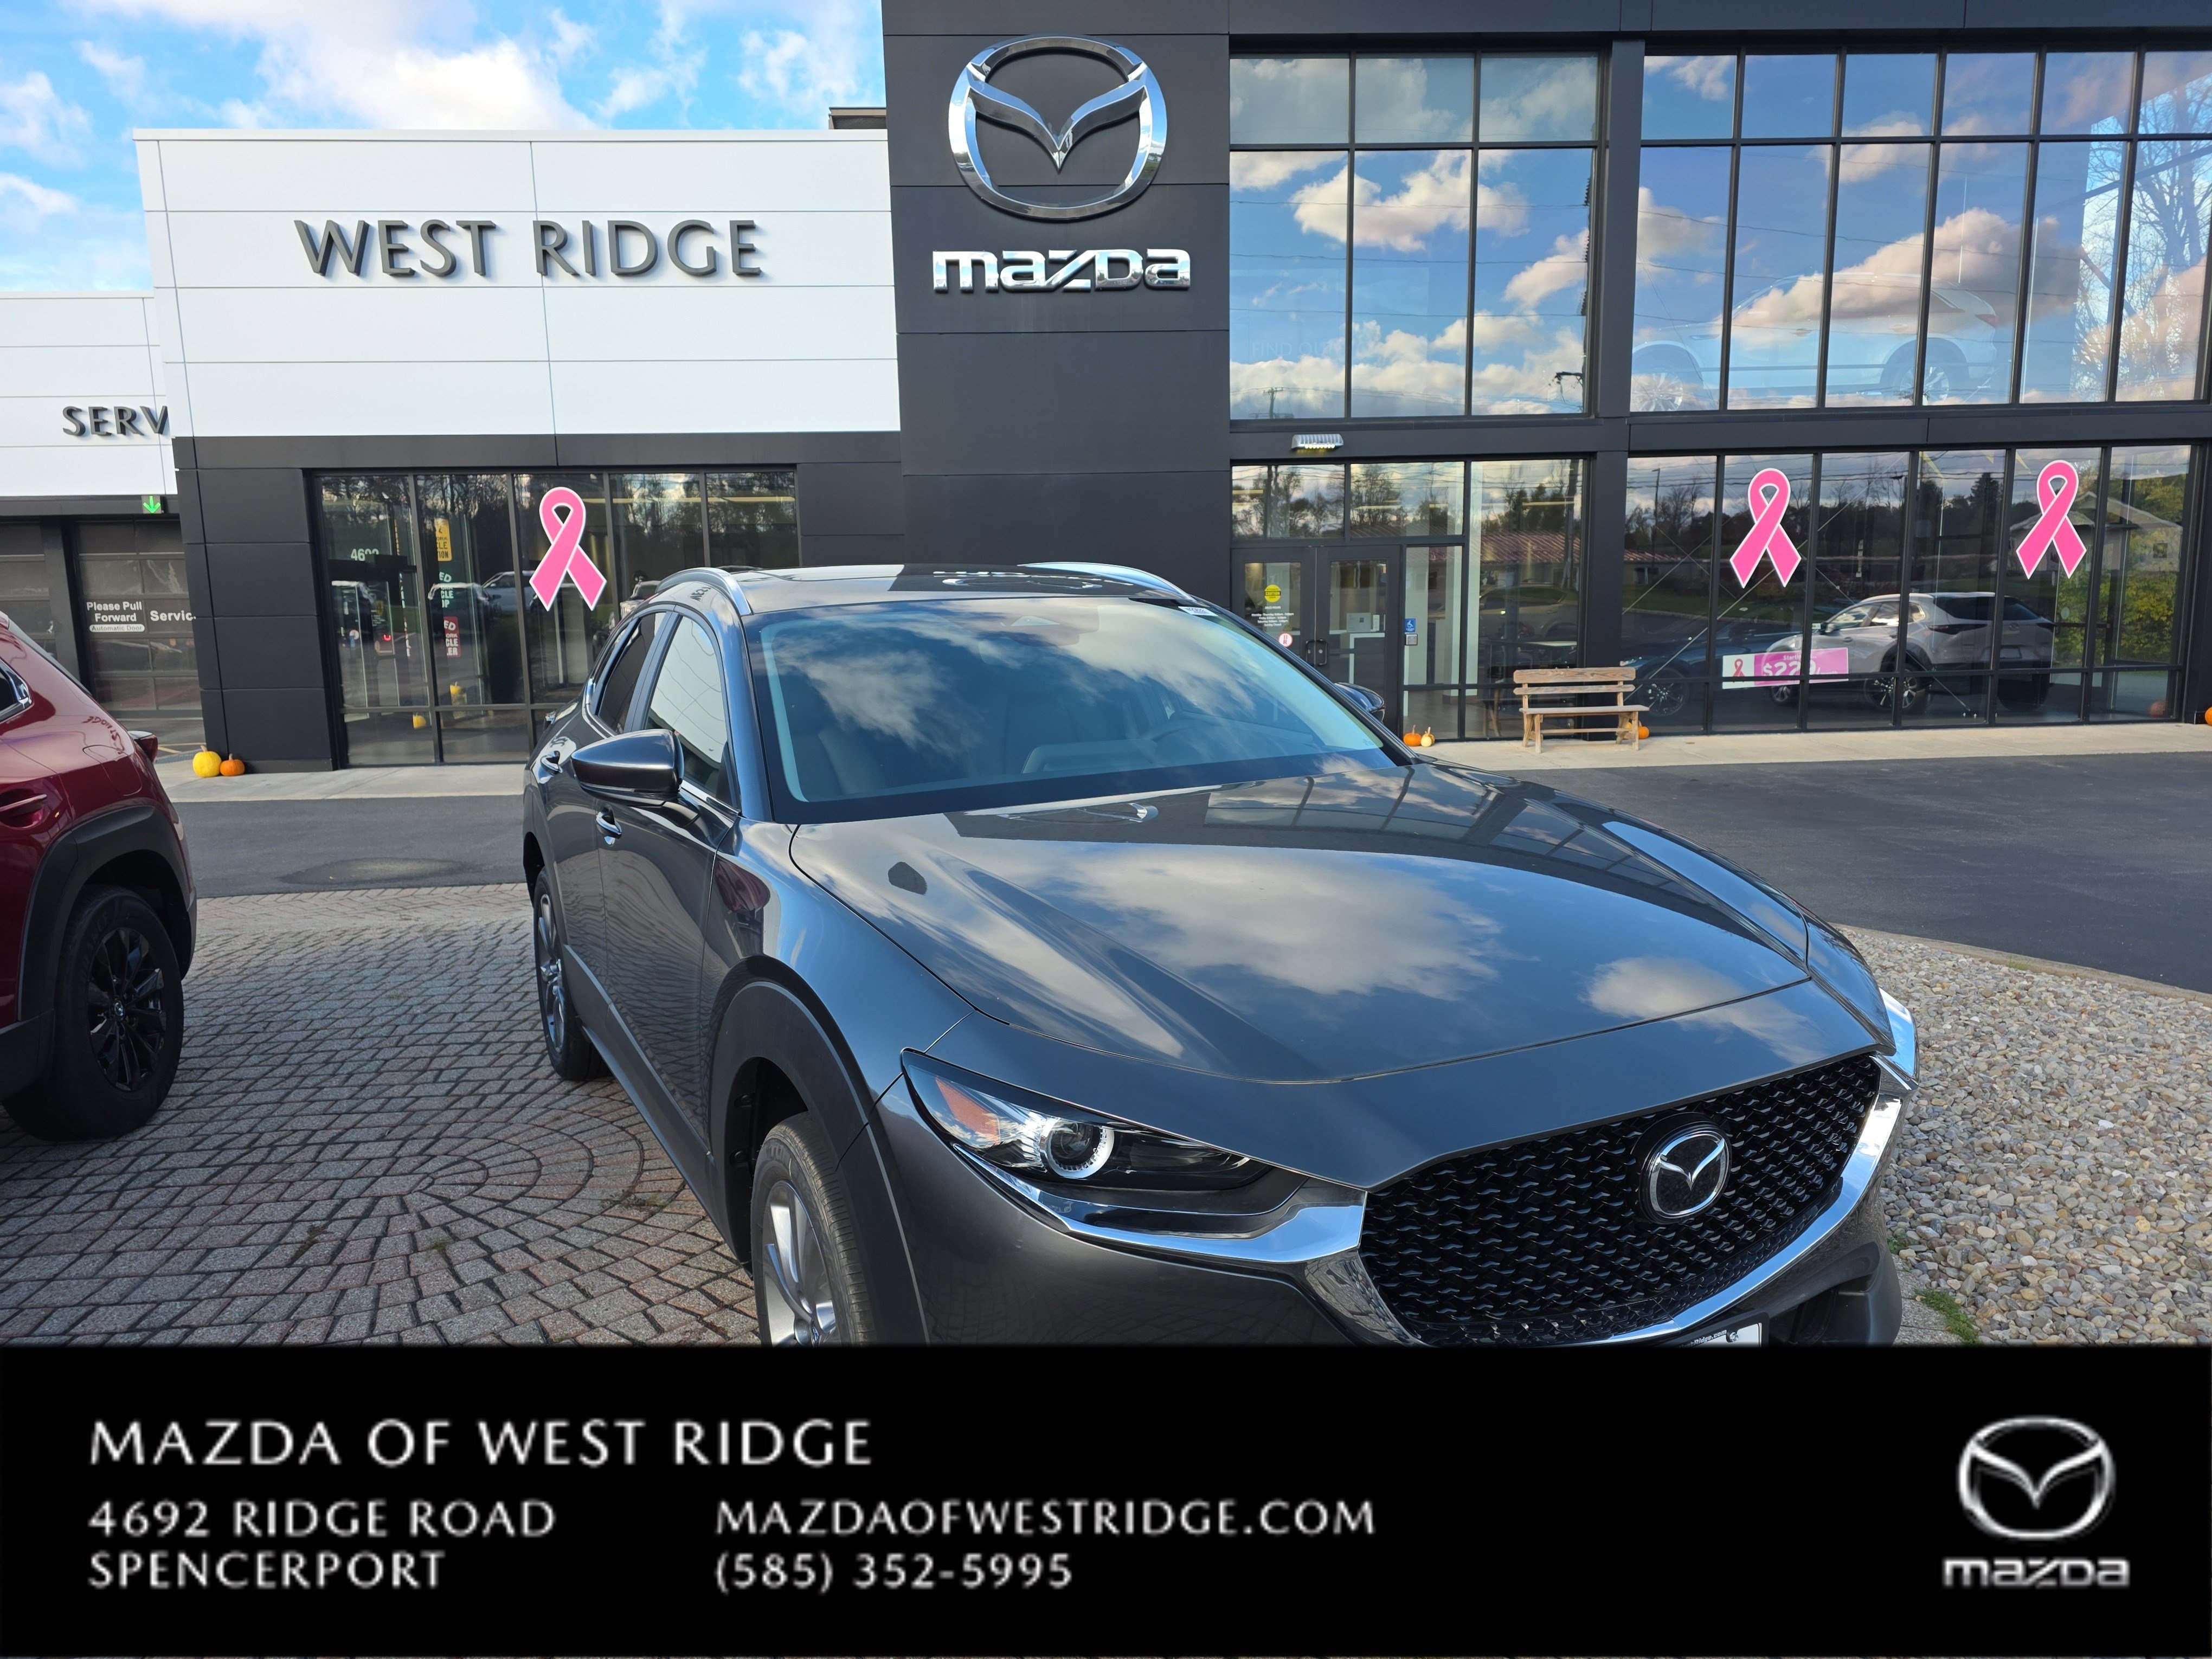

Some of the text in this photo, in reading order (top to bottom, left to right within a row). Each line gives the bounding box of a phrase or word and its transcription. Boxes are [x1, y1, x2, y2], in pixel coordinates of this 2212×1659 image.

[294, 220, 763, 278] WEST RIDGE
[62, 406, 169, 438] SERV
[86, 601, 143, 611] Please Pull
[94, 613, 137, 622] Forward
[150, 610, 196, 622] Servic
